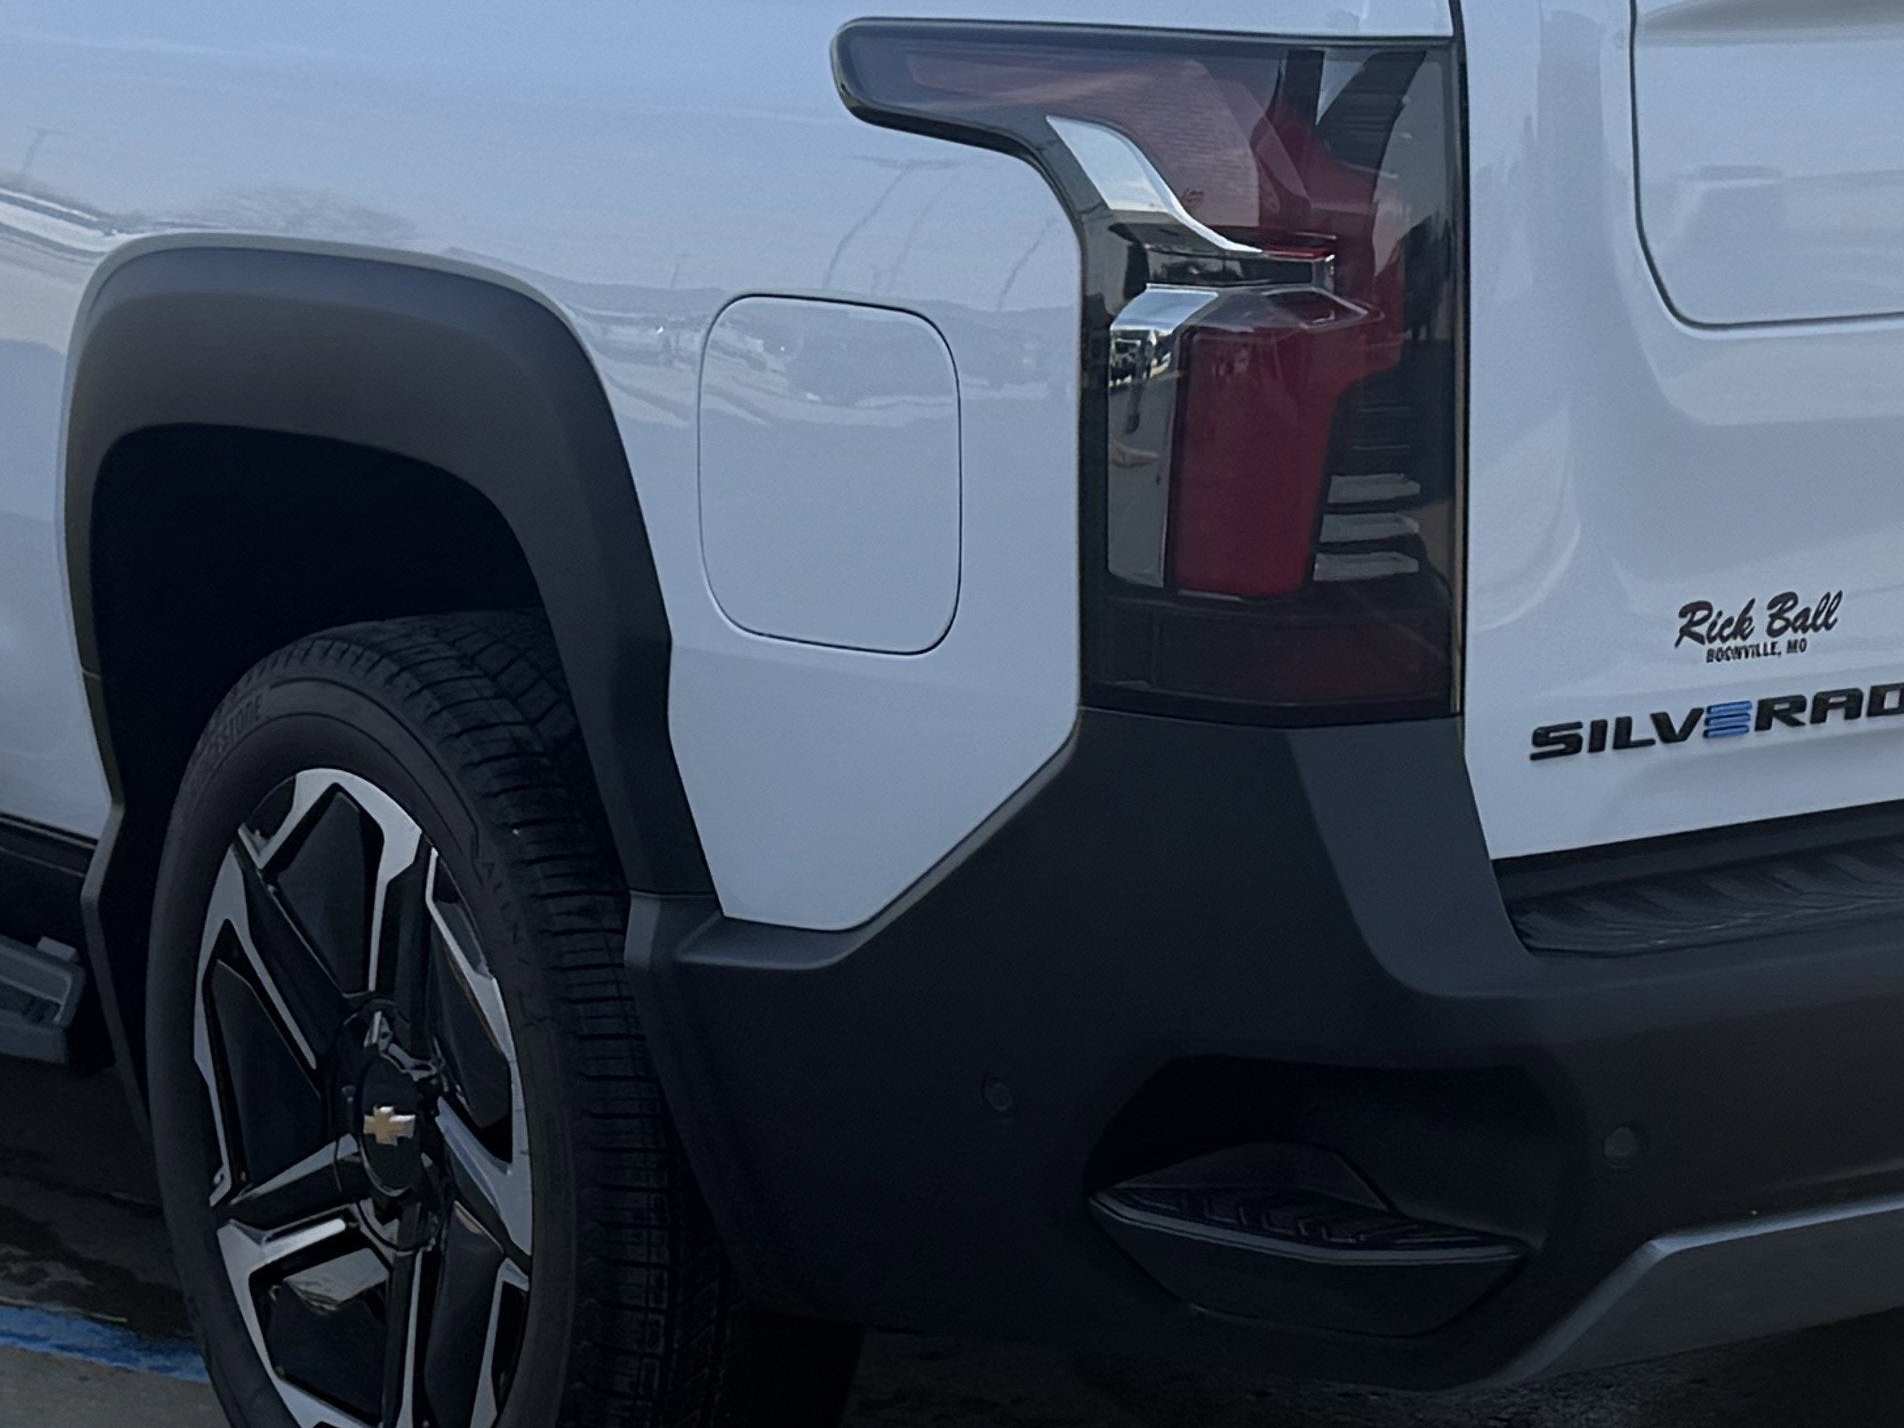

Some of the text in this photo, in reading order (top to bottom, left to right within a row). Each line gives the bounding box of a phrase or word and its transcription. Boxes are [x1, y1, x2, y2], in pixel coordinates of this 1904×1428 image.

[1674, 590, 1844, 649] Rick Ball
[1706, 637, 1808, 664] BOONVILLE, MO
